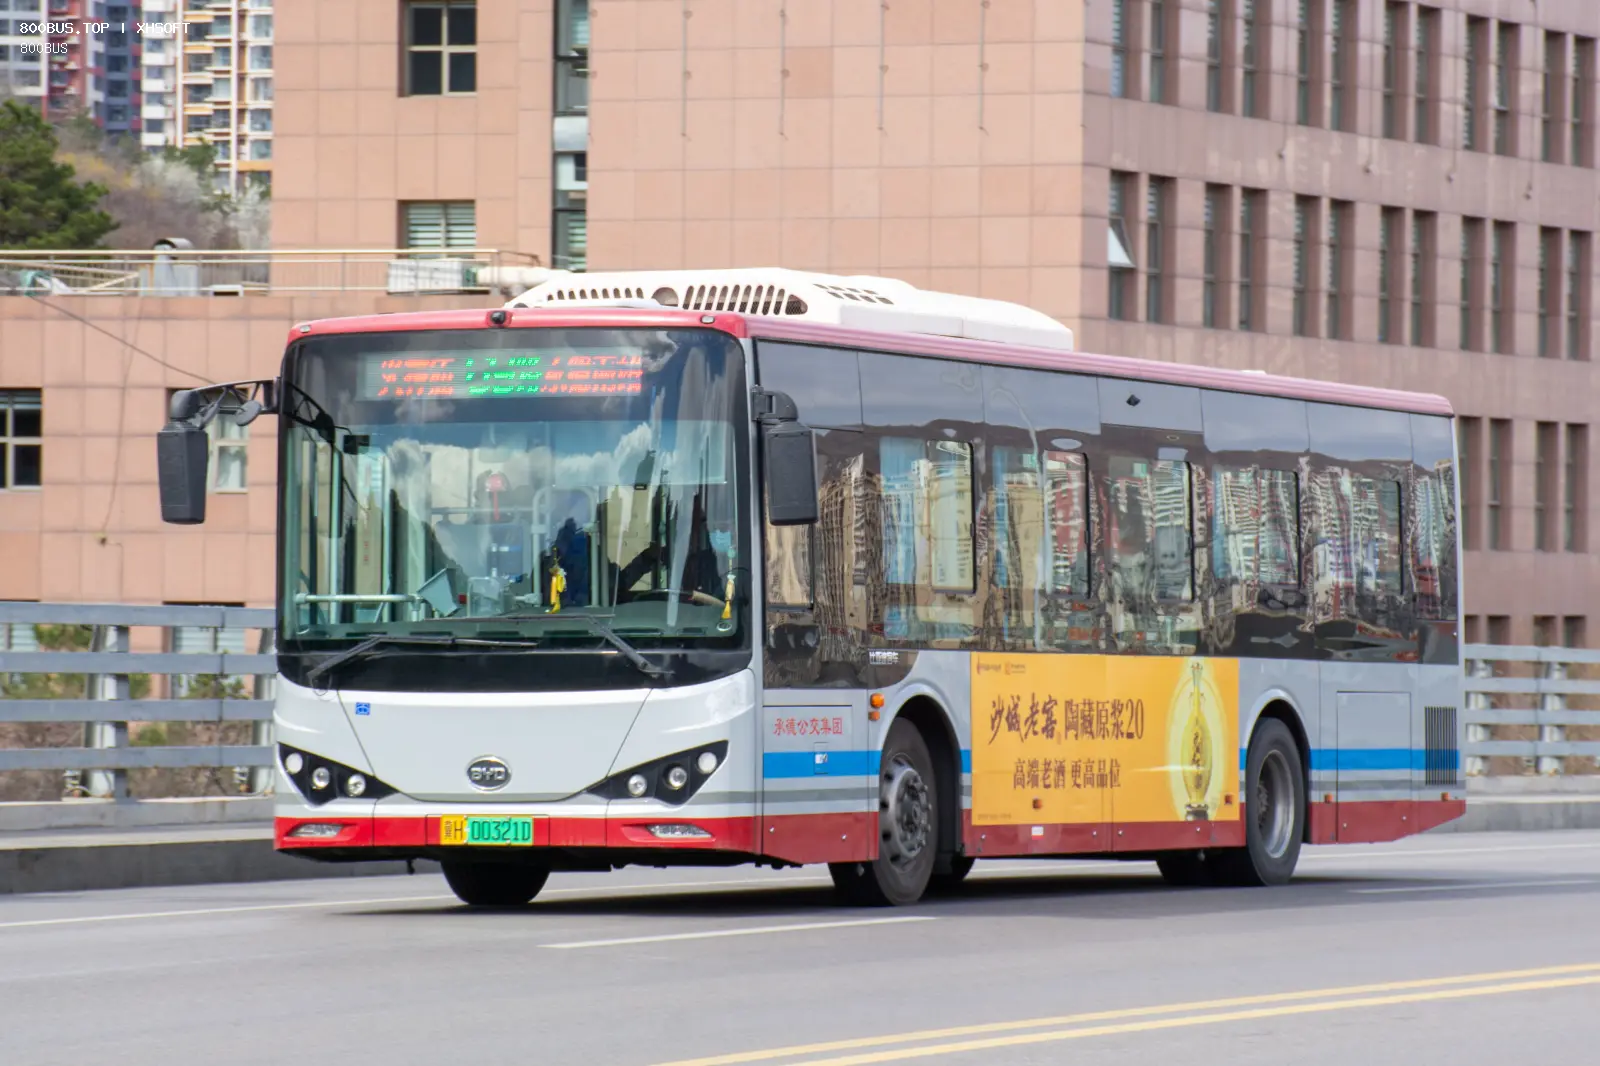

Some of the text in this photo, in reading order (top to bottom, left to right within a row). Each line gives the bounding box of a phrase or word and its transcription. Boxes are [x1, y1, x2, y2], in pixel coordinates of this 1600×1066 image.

[773, 717, 843, 736] 承德公交集团
[470, 767, 506, 781] BYD
[1013, 757, 1121, 790] 高端老酒 更高品位
